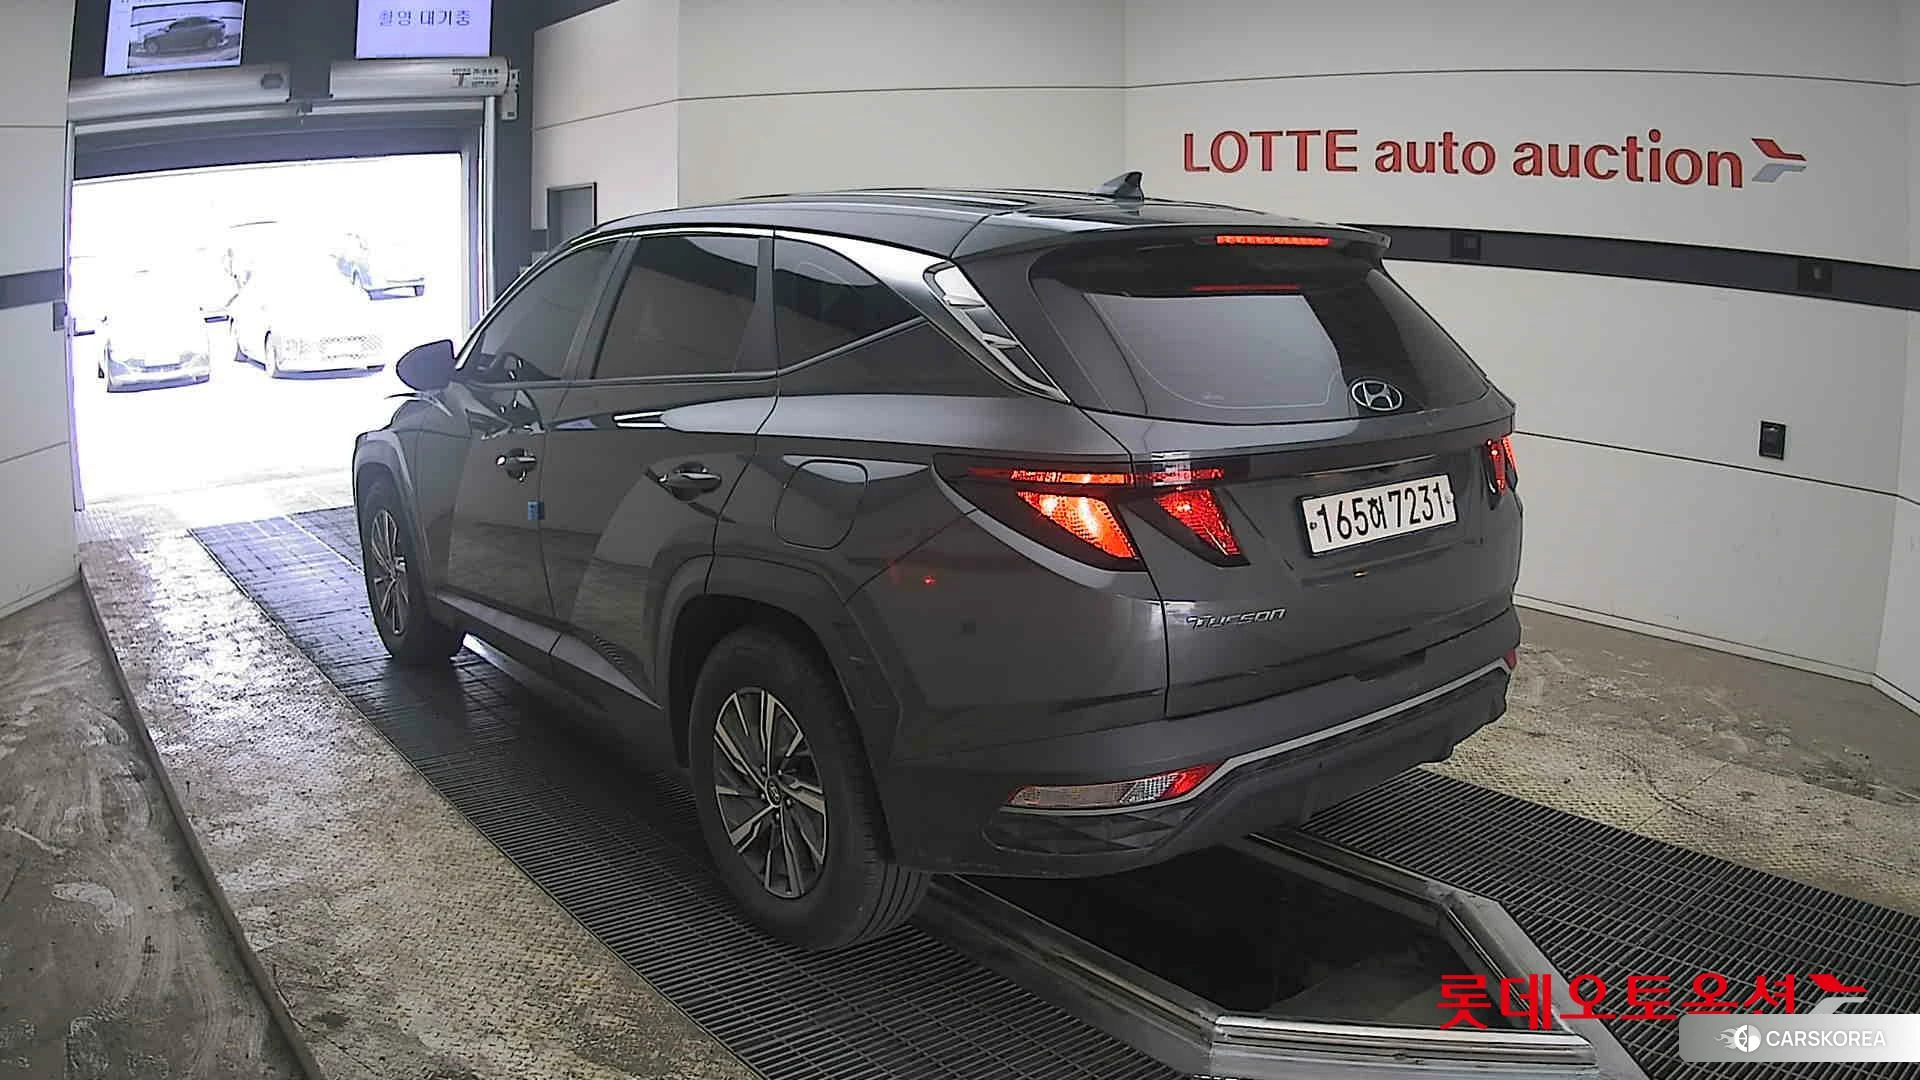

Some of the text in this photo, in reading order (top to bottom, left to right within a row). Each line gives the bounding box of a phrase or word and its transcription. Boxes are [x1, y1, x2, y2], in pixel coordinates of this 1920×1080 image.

[1184, 128, 1744, 189] LOTTE auto auction
[1186, 607, 1287, 631] TUCSON
